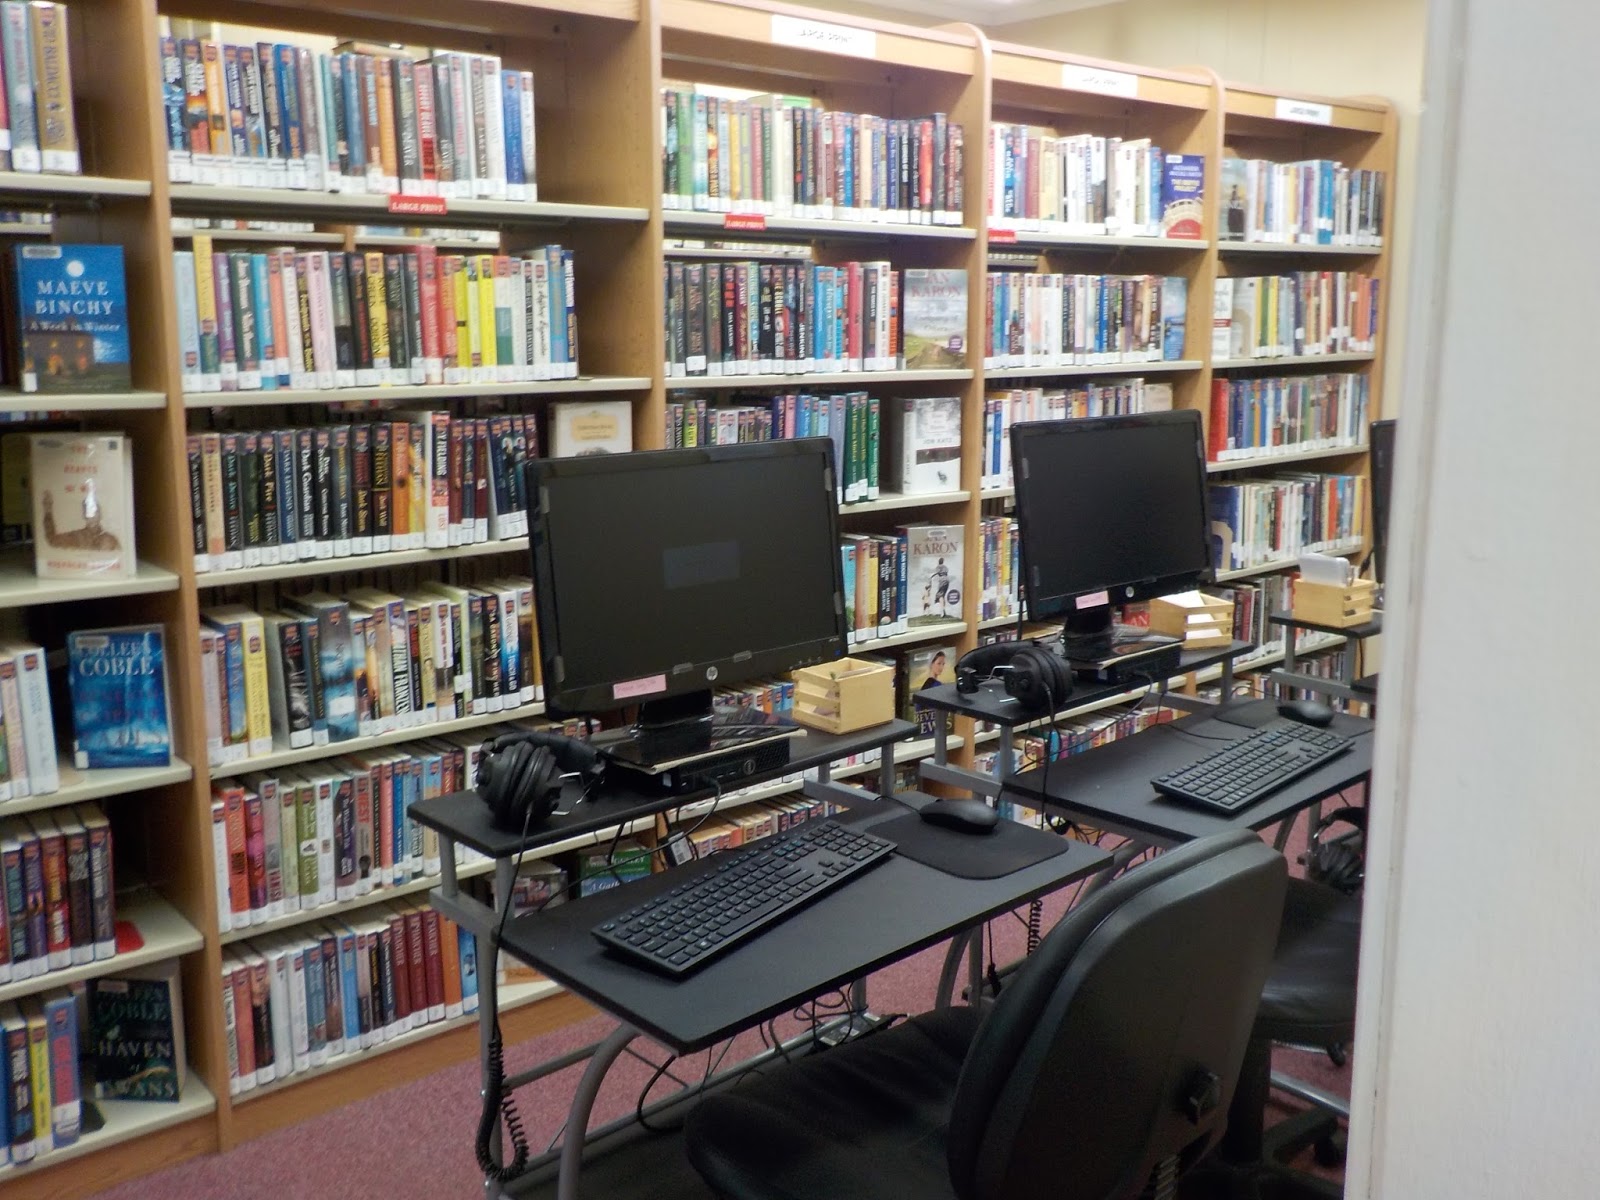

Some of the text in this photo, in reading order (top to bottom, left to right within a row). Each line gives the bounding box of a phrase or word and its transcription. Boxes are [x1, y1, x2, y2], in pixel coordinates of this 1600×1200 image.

[37, 280, 109, 296] MAEVE
[35, 300, 113, 316] BINCHY
[263, 453, 274, 478] Dark
[436, 440, 448, 476] FIELDING
[282, 449, 293, 511] DARK LEGEND
[301, 448, 314, 513] Dark Guardian
[913, 541, 958, 555] KARON
[79, 656, 155, 677] COBLE
[99, 1040, 171, 1058] HAVEN
